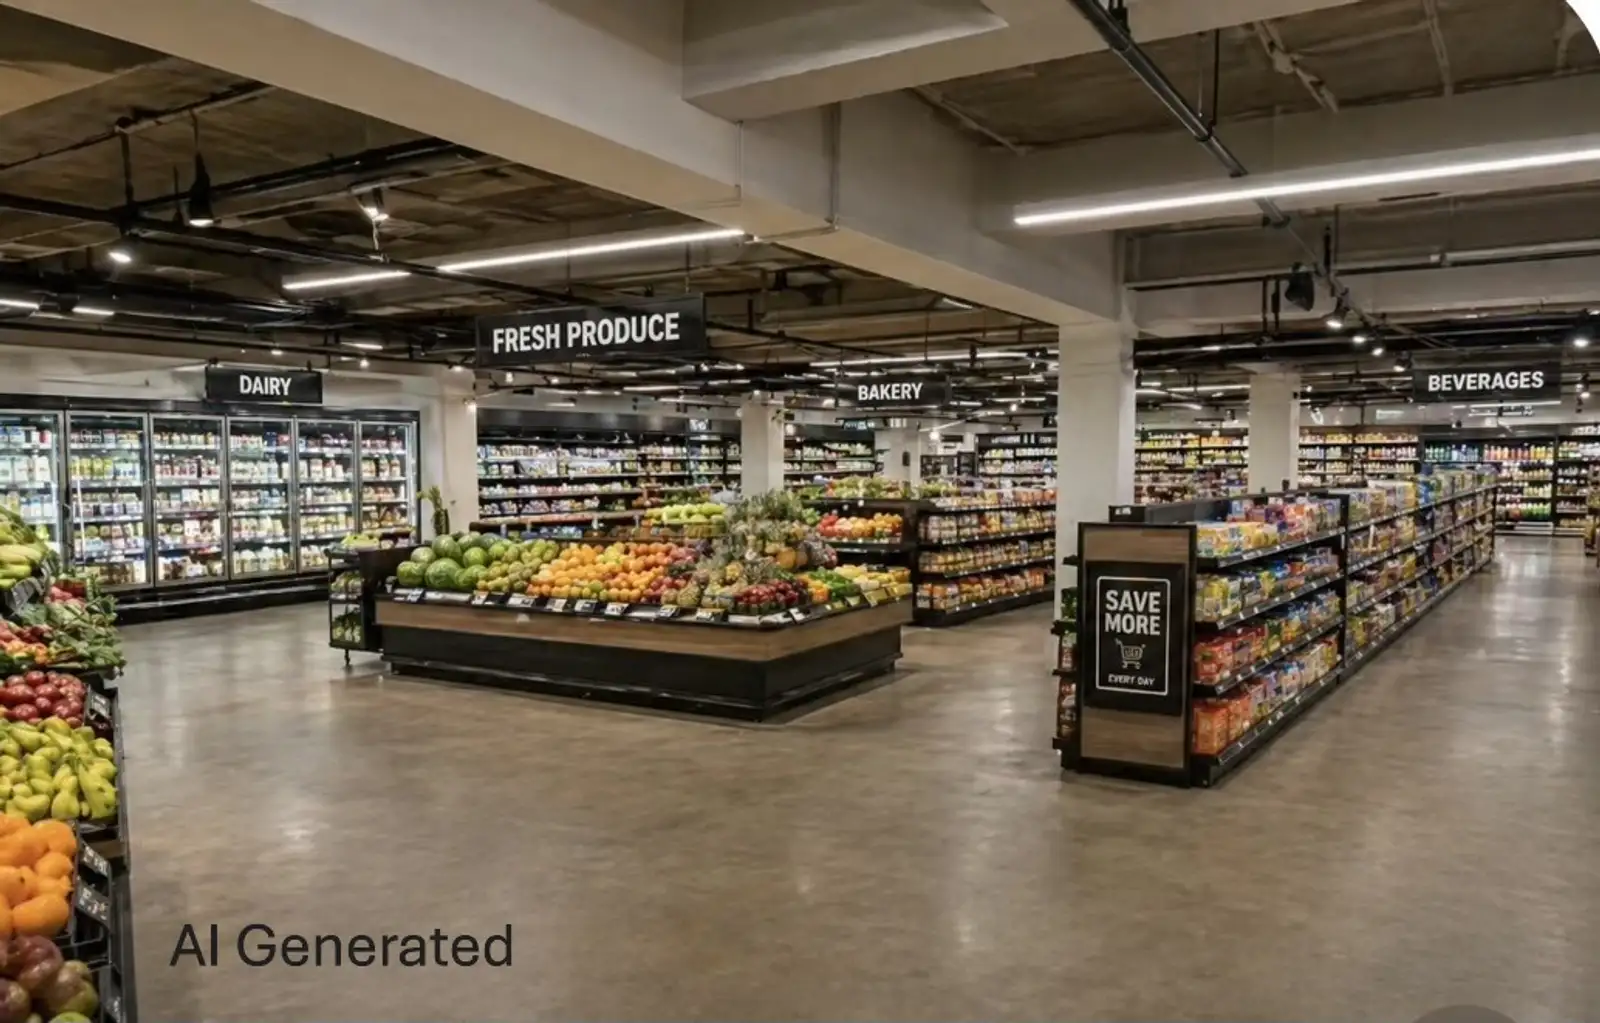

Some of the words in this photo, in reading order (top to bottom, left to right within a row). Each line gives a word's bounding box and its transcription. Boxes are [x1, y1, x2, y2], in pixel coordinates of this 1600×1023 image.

[493, 323, 561, 354] FRESH
[567, 312, 681, 348] PRODUCE
[239, 374, 292, 396] DAIRY
[857, 382, 923, 401] BAKERY
[1428, 371, 1544, 392] BEVERAGES
[1105, 589, 1161, 613] SAVE
[1104, 612, 1161, 636] MORE
[1108, 673, 1136, 684] EVERY
[1137, 675, 1155, 686] DAY
